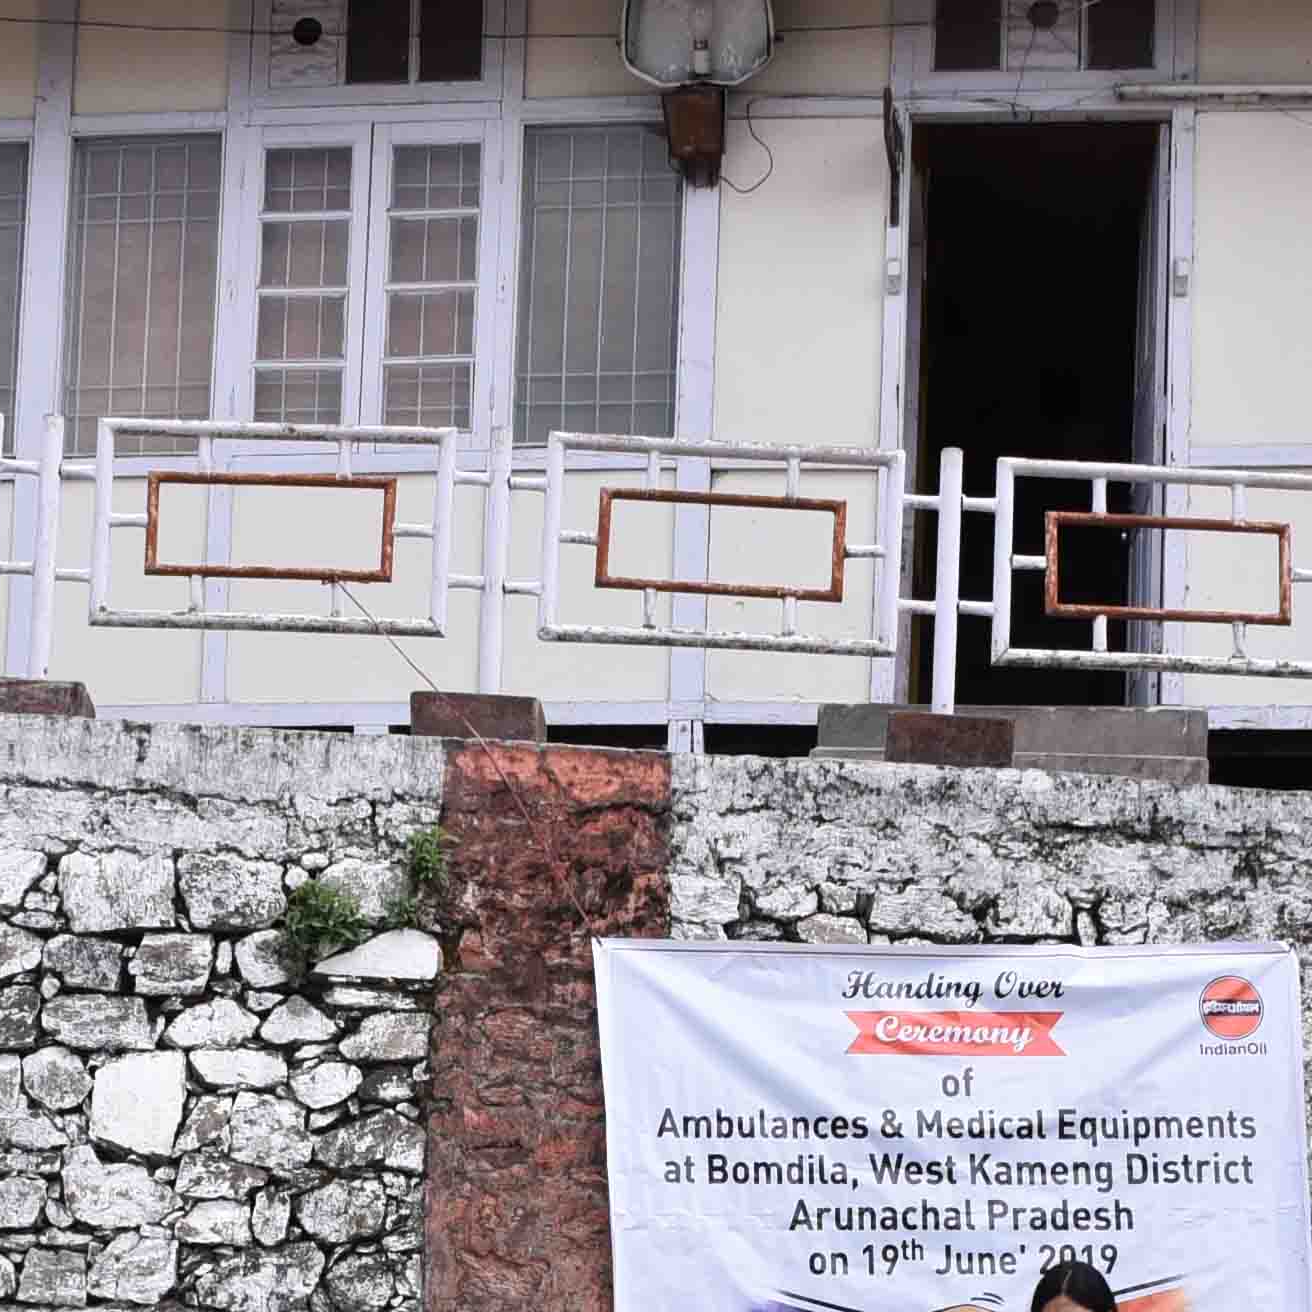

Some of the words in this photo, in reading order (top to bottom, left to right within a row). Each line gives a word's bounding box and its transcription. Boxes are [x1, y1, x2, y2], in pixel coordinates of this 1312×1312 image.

[841, 970, 983, 1008] Handing
[994, 969, 1065, 999] Over
[874, 1015, 1034, 1053] Ceremony
[1199, 1042, 1267, 1056] IndianOil
[941, 1067, 974, 1097] of
[657, 1108, 869, 1139] Ambulances
[879, 1109, 904, 1139] &
[916, 1109, 1047, 1140] Medical
[1058, 1109, 1257, 1147] Equipments
[663, 1155, 696, 1184] at
[706, 1153, 859, 1190] Bomdila,
[868, 1152, 958, 1185] West
[969, 1153, 1113, 1193] Kameng
[1126, 1152, 1254, 1185] District
[789, 1199, 975, 1231] Arunachal
[988, 1199, 1134, 1231] Pradesh
[808, 1251, 849, 1275] on
[862, 1238, 925, 1276] 19th
[935, 1244, 1026, 1275] June'
[1038, 1244, 1118, 1275] 2019
